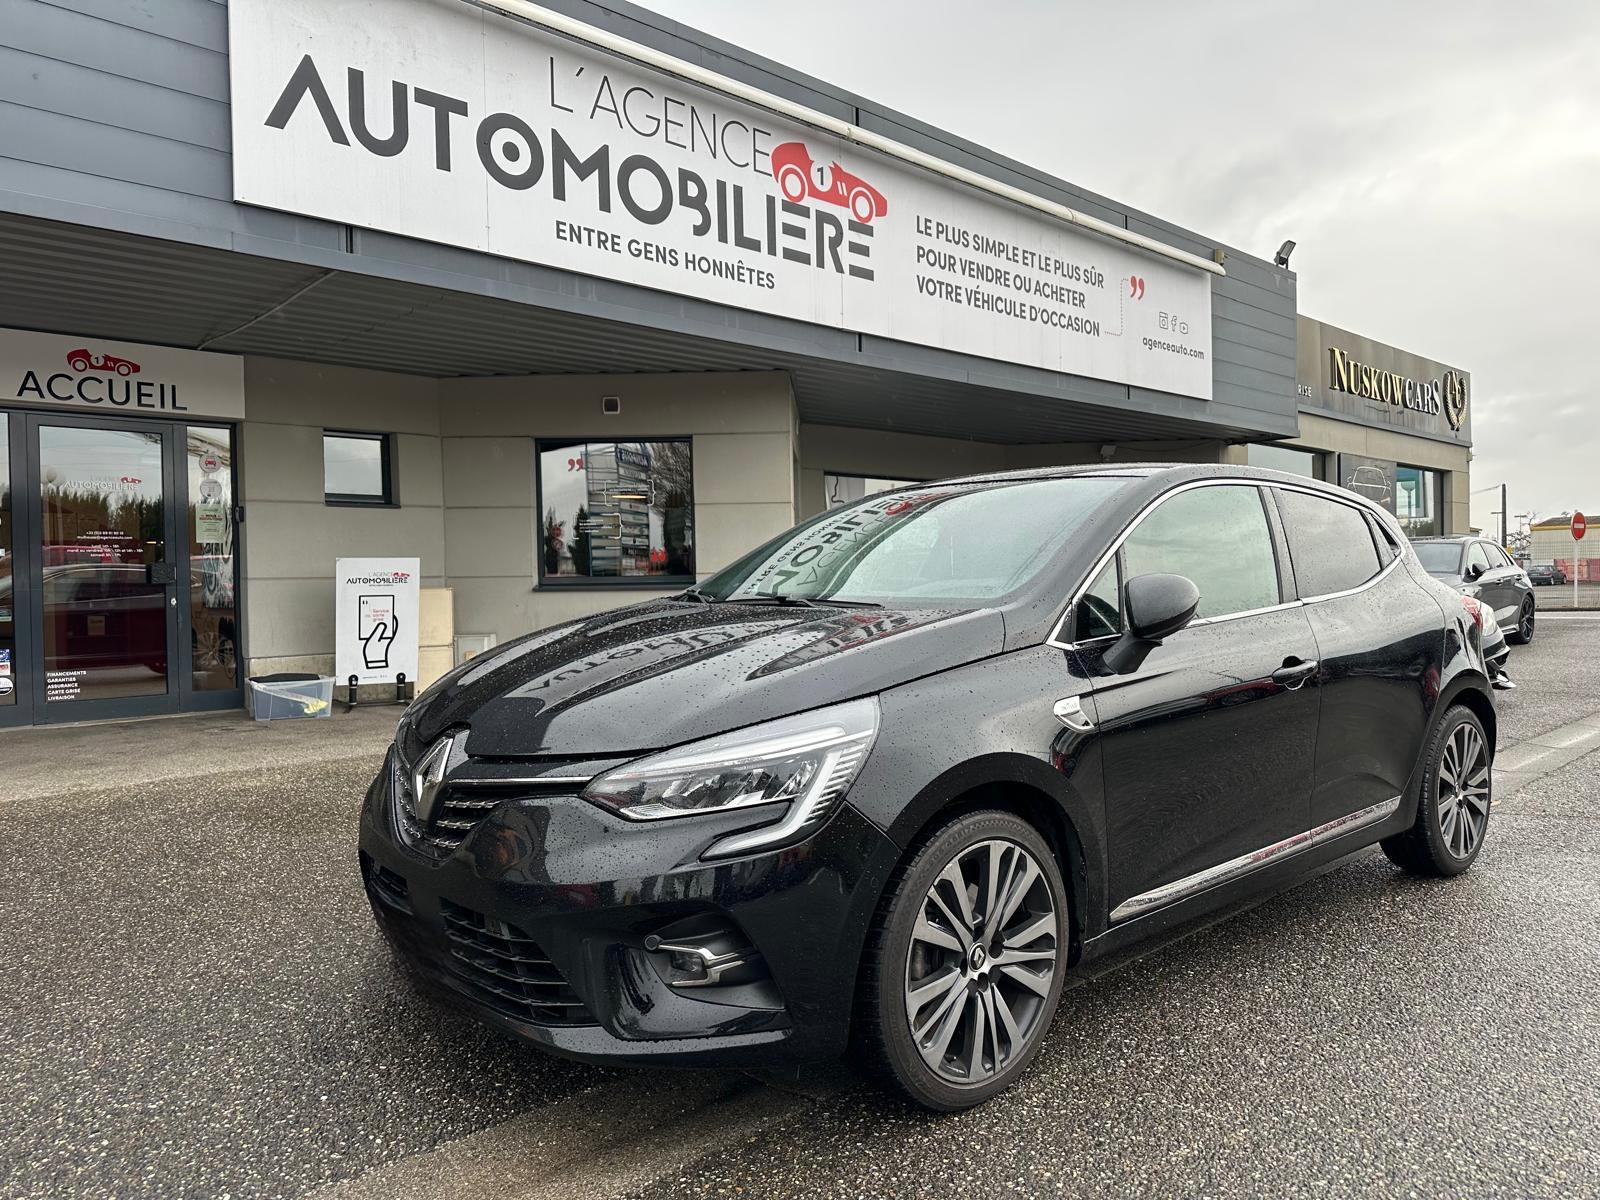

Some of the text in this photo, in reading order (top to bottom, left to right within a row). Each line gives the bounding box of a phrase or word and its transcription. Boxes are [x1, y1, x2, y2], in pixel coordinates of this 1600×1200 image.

[555, 220, 776, 290] ENTRE GENS HONNÊTES
[916, 215, 1105, 289] LE PLUS SIMPLE ET LE PLUS SÛR
[916, 246, 1086, 309] POUR VENDRE OU ACHETER
[916, 275, 1101, 337] VOTRE VÉHICULE D'OCCASION
[1142, 336, 1205, 361] agenceauto.com
[17, 371, 188, 412] ACCUEIL
